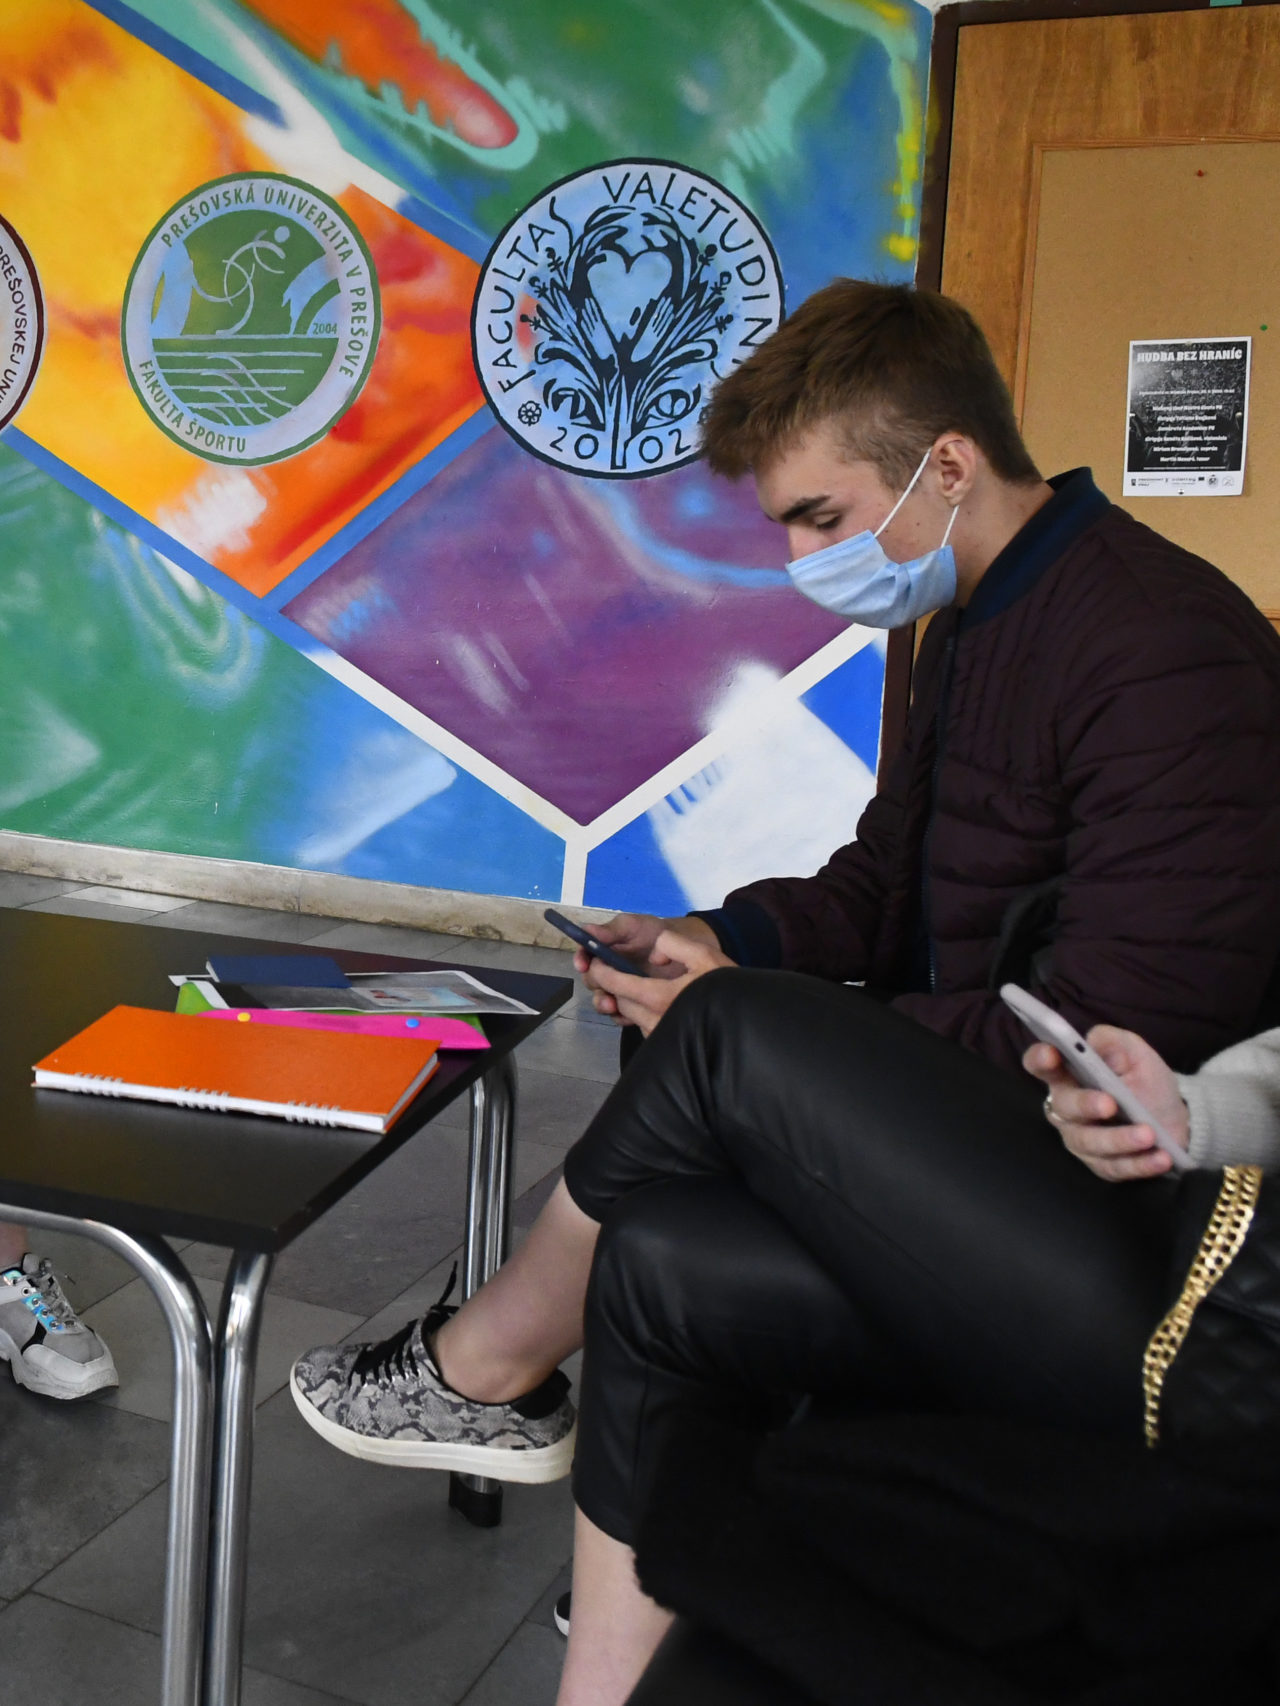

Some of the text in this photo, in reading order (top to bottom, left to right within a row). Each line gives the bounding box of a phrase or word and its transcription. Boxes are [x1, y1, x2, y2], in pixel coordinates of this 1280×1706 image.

[161, 183, 369, 378] PREŠOVSKÁ UNIVERZITA V PREŠOVE
[487, 171, 773, 394] FACULTAS VALETUDIN
[313, 322, 337, 335] 2004
[1136, 347, 1243, 362] HUDBA BEZ HRANÍC
[139, 360, 247, 453] FAKULTA ŠPORTU
